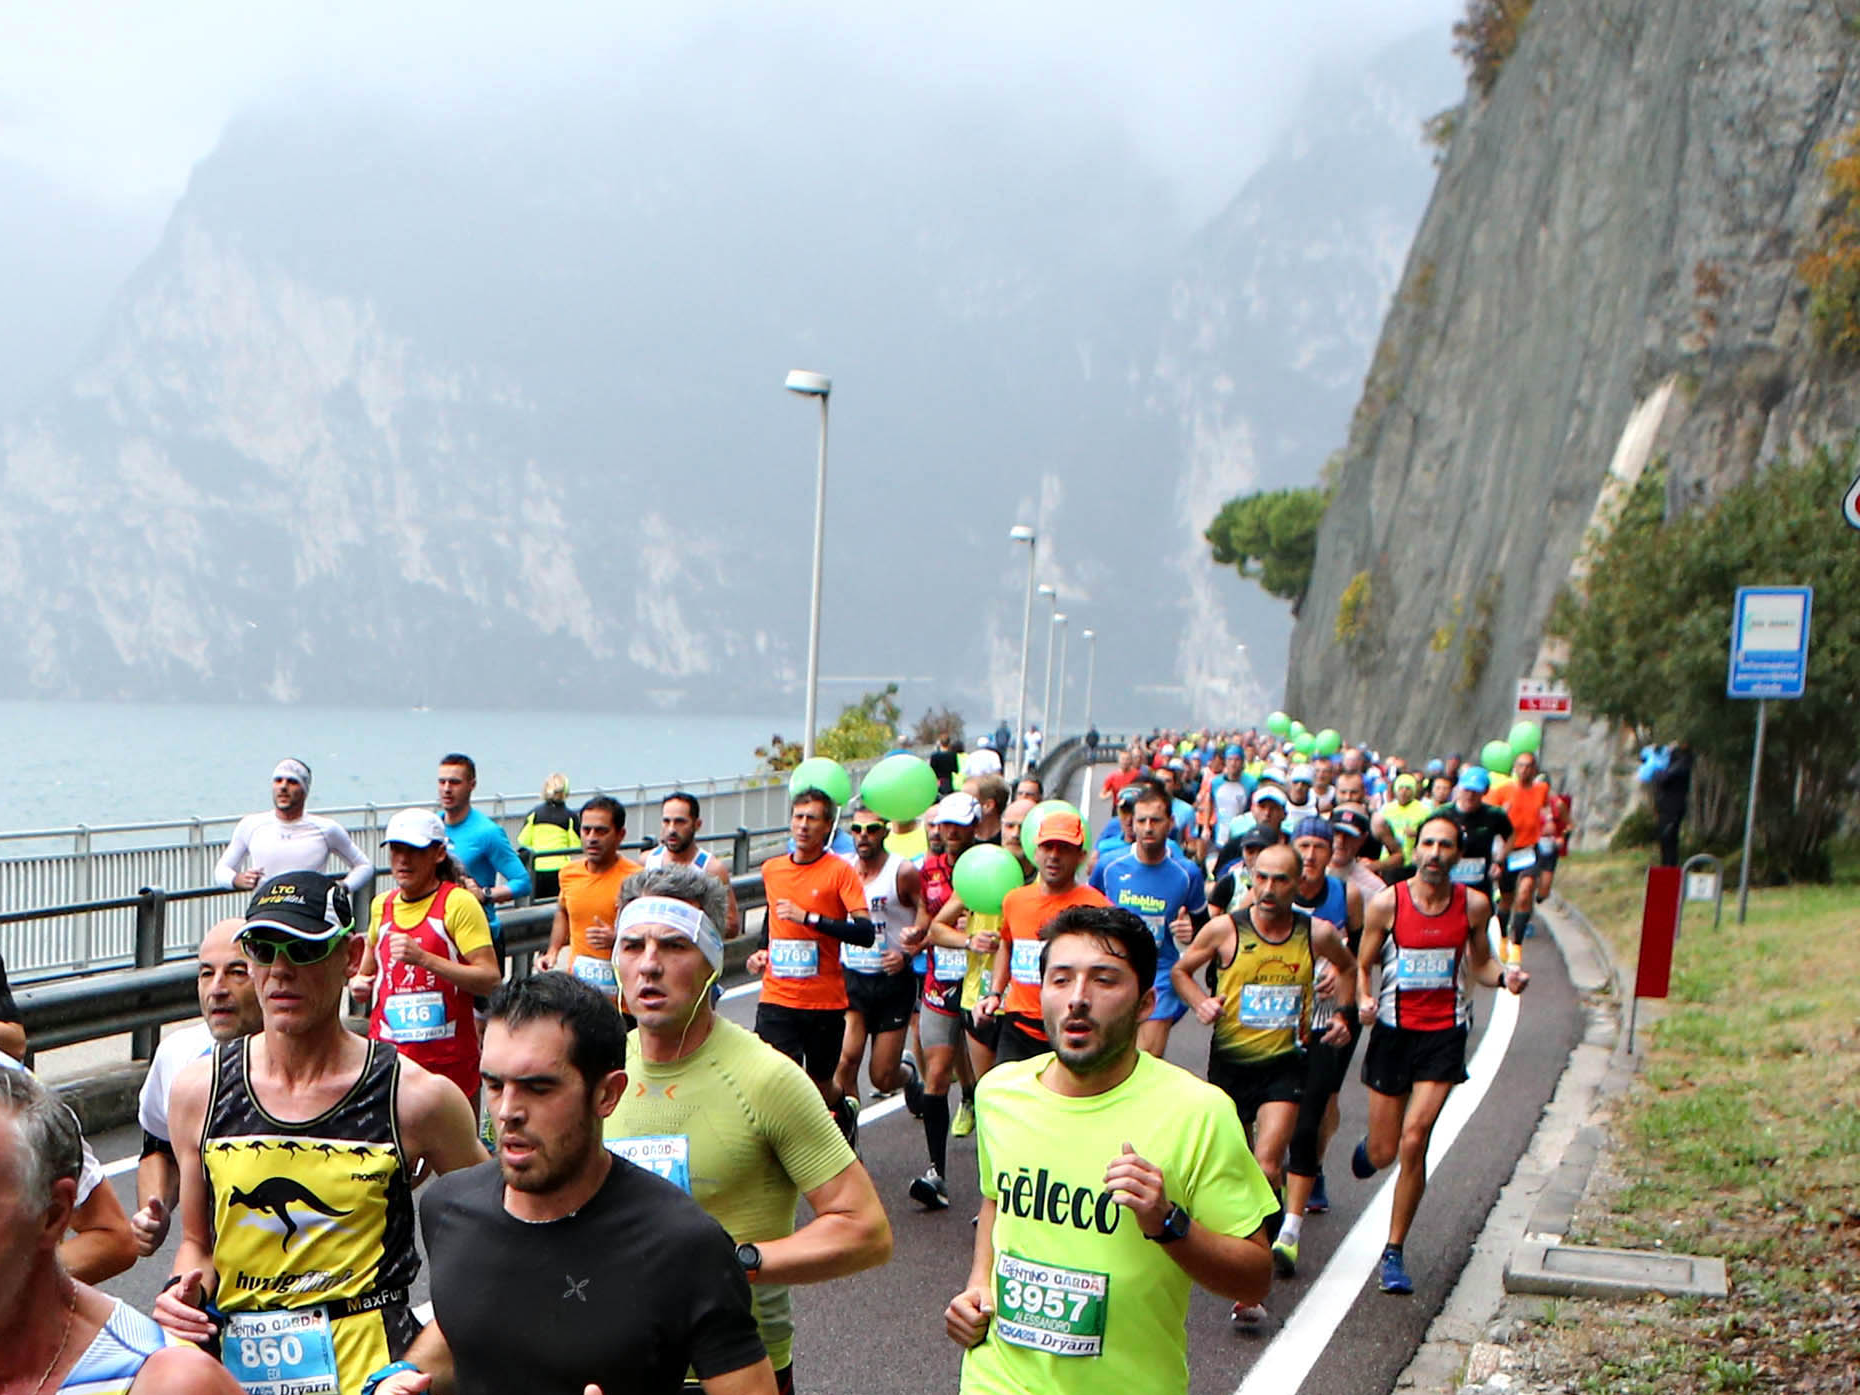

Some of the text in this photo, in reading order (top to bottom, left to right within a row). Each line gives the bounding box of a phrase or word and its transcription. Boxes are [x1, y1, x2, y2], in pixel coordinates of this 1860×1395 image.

[271, 885, 296, 895] LTC
[399, 1005, 431, 1023] 146
[1002, 1258, 1101, 1292] TRENTINO GARDA
[1003, 1279, 1089, 1323] 3957
[1011, 1311, 1072, 1333] ALESSANDRO
[241, 1335, 304, 1369] 860
[1040, 1333, 1096, 1354] Dryarn
